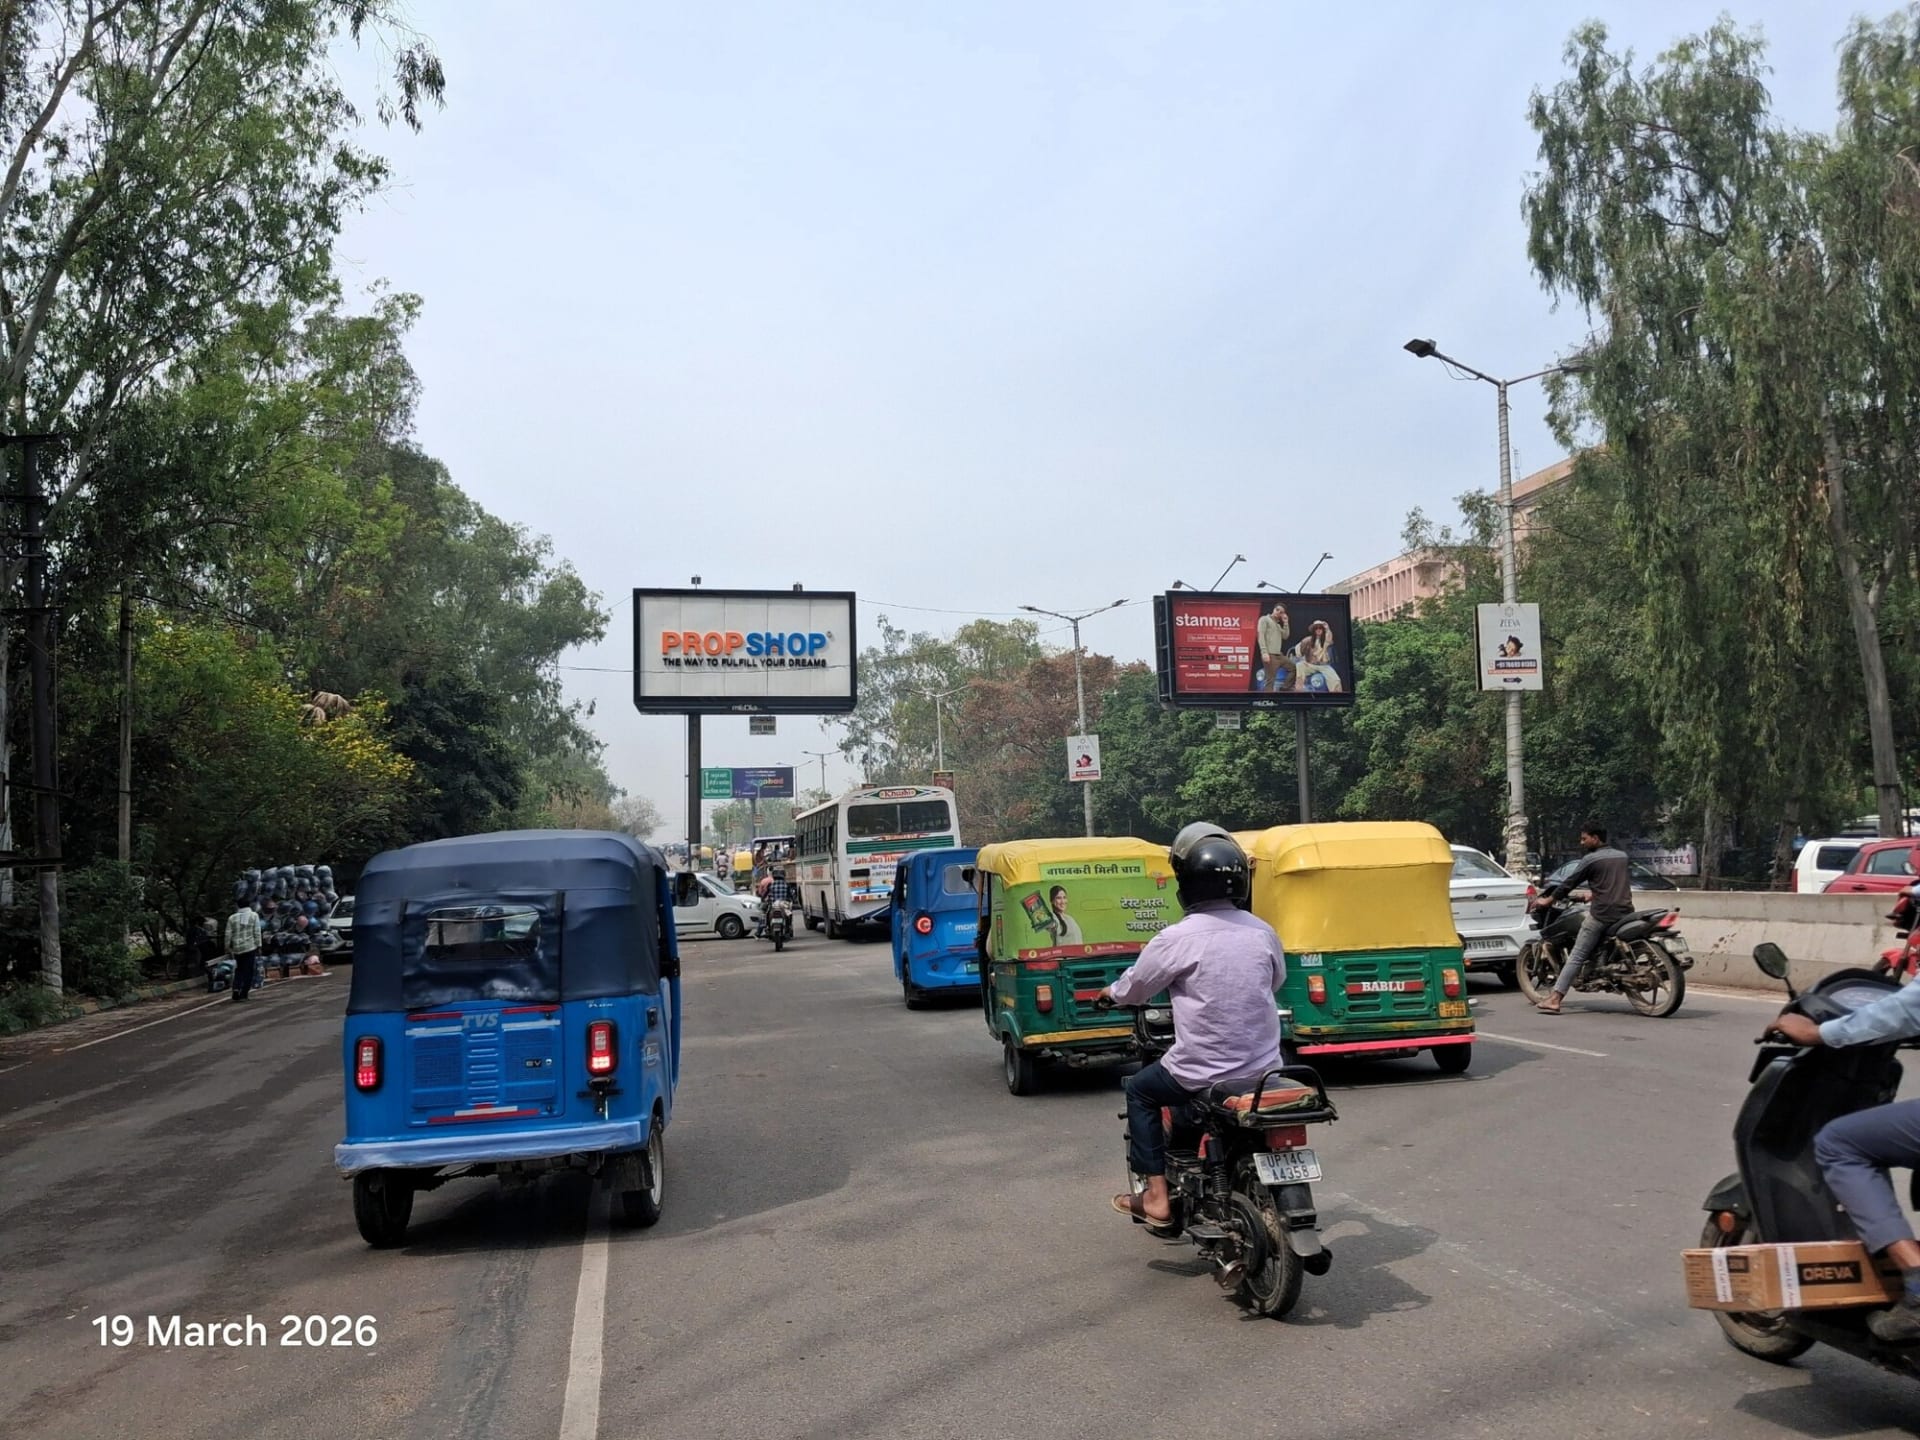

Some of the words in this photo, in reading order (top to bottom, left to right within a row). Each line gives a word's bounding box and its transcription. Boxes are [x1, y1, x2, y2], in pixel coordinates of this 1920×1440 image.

[1176, 613, 1240, 627] stanmax
[661, 631, 827, 657] PROPSHOP
[663, 658, 681, 667] THE
[684, 658, 703, 667] WAY
[706, 658, 718, 667] TO
[721, 658, 758, 668] FULFILL
[760, 658, 786, 668] YOUR
[788, 658, 827, 668] DREAMS
[1361, 981, 1406, 992] BABLU
[461, 1013, 499, 1029] TVS
[1267, 1152, 1305, 1168] UP14C
[1272, 1165, 1309, 1181] A4358
[1802, 1266, 1854, 1281] OREVA
